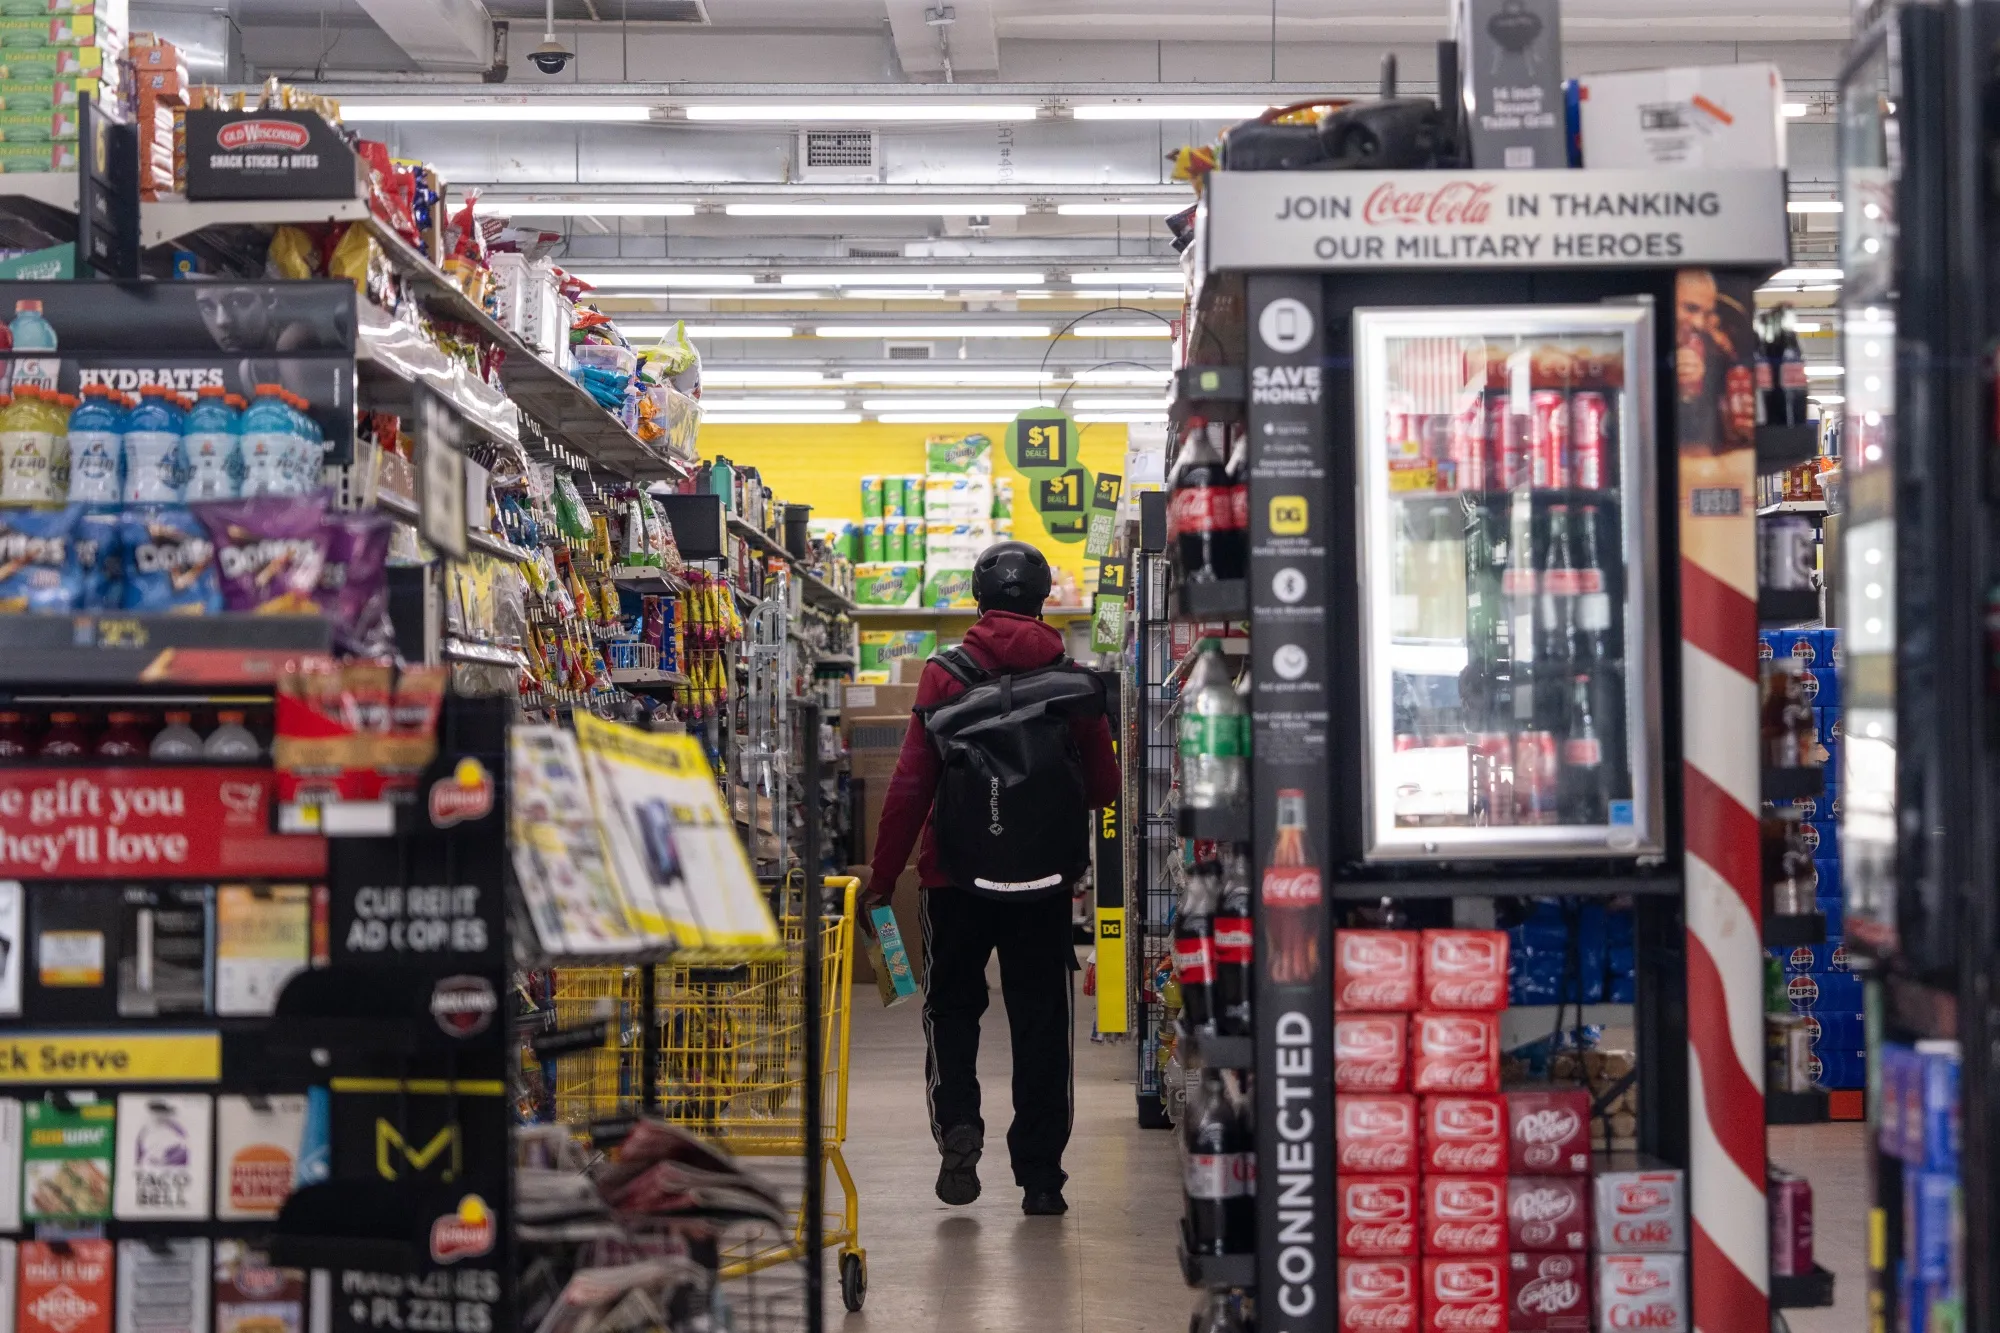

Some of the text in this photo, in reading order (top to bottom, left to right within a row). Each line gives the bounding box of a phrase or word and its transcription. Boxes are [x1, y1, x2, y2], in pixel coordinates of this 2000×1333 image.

[223, 129, 245, 143] OLD
[210, 155, 243, 169] SNACK
[244, 155, 279, 169] STICKS
[291, 154, 319, 169] BITES
[1276, 182, 1720, 226] JOIN Coca-Cola IN THANKING
[1314, 232, 1684, 260] OUR MILITARY HEROES
[79, 368, 224, 389] HYDRATES
[1252, 366, 1321, 387] SAVE
[1252, 387, 1321, 405] MONEY
[1025, 449, 1047, 457] DEALS
[1028, 425, 1059, 461] $1
[1050, 475, 1077, 506] $1
[1100, 479, 1119, 503] $1
[1093, 514, 1113, 525] JUST
[1276, 507, 1301, 523] DG
[1091, 523, 1111, 534] ONE
[1087, 544, 1108, 556] DAY
[1104, 563, 1125, 588] $1
[870, 577, 903, 597] Bounty
[1099, 601, 1121, 612] JUST
[1099, 611, 1120, 621] ONE
[877, 642, 919, 663] Bounty
[29, 779, 100, 825] gift
[104, 786, 185, 824] you
[0, 829, 188, 872] hey'll love
[345, 918, 389, 952] AD
[1102, 923, 1120, 936] DG
[1789, 988, 1817, 996] PEPSI
[40, 1045, 130, 1072] Serve
[1276, 1011, 1316, 1318] CONNECTED
[135, 1170, 190, 1188] TACO
[135, 1187, 189, 1207] BELL
[1613, 1220, 1673, 1244] Coke
[1609, 1302, 1678, 1329] Coke
